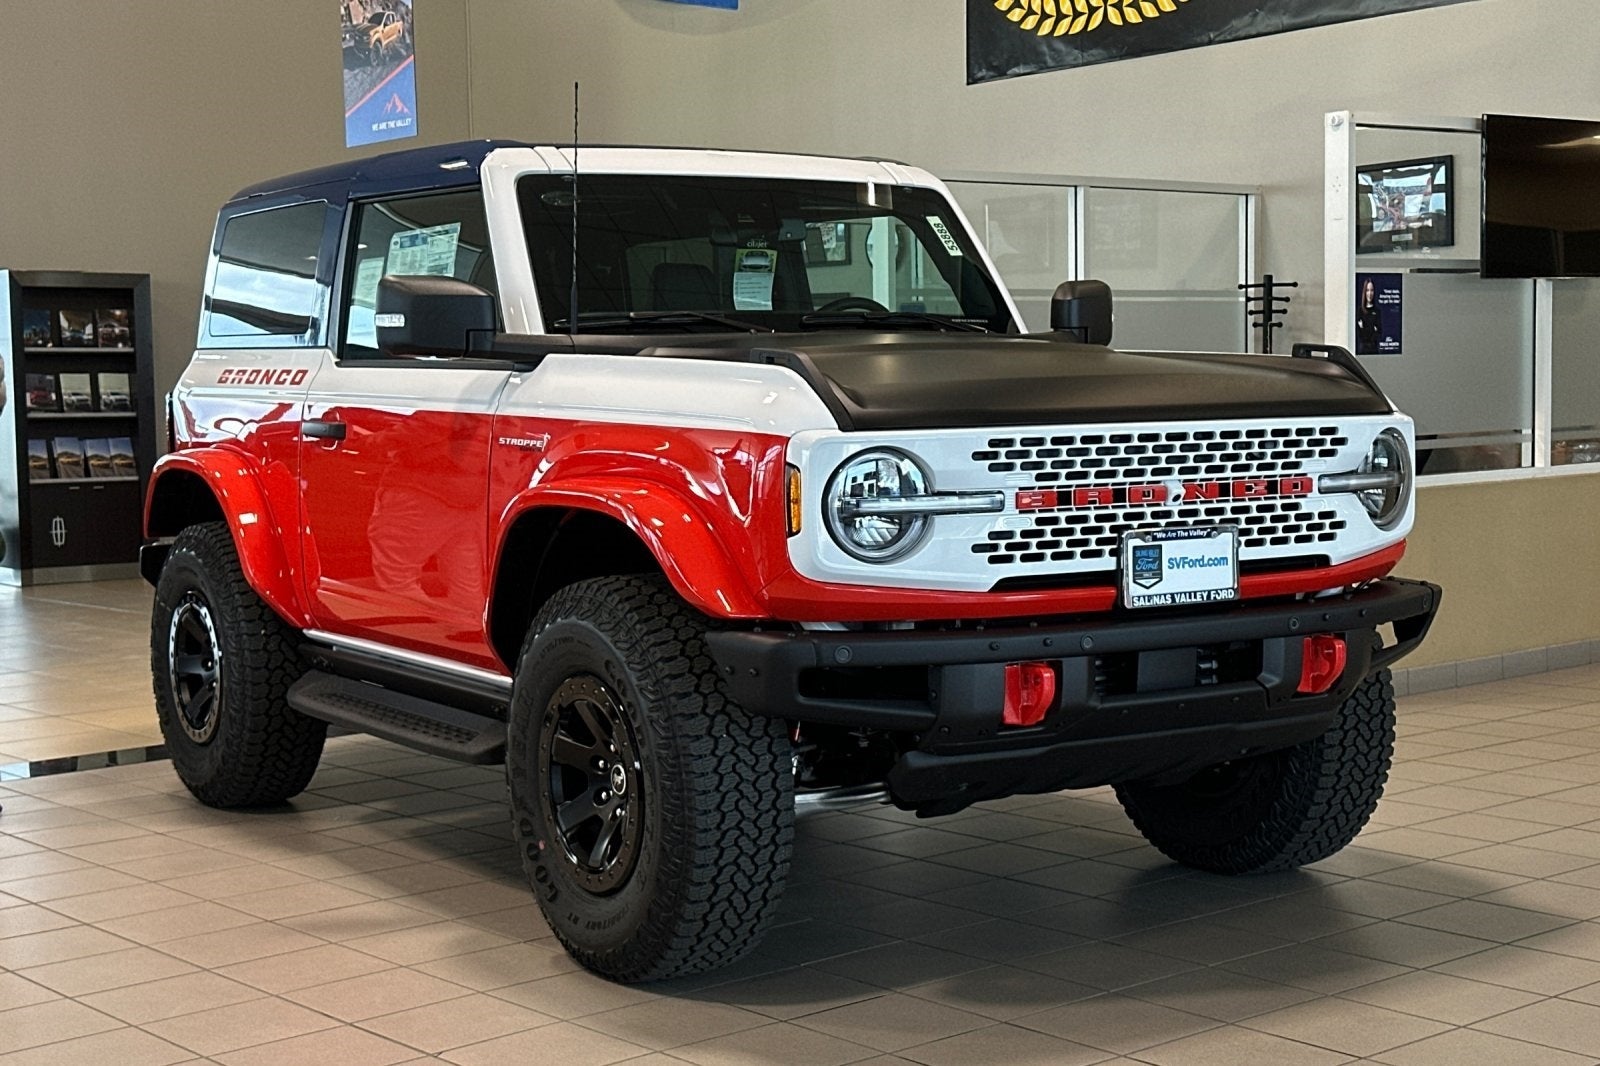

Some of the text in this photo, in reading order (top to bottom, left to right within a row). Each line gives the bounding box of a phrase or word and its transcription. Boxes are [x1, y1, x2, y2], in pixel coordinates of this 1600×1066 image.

[387, 120, 396, 128] THE
[396, 118, 412, 127] VALLEY
[933, 223, 958, 251] 53888
[216, 368, 309, 386] BRONCO
[498, 437, 544, 448] STROPPE
[1015, 476, 1313, 510] BRONCO
[1135, 557, 1159, 571] Ford
[1167, 555, 1228, 569] SVFord.com
[1133, 588, 1235, 607] SALINAS VALLEY FORD
